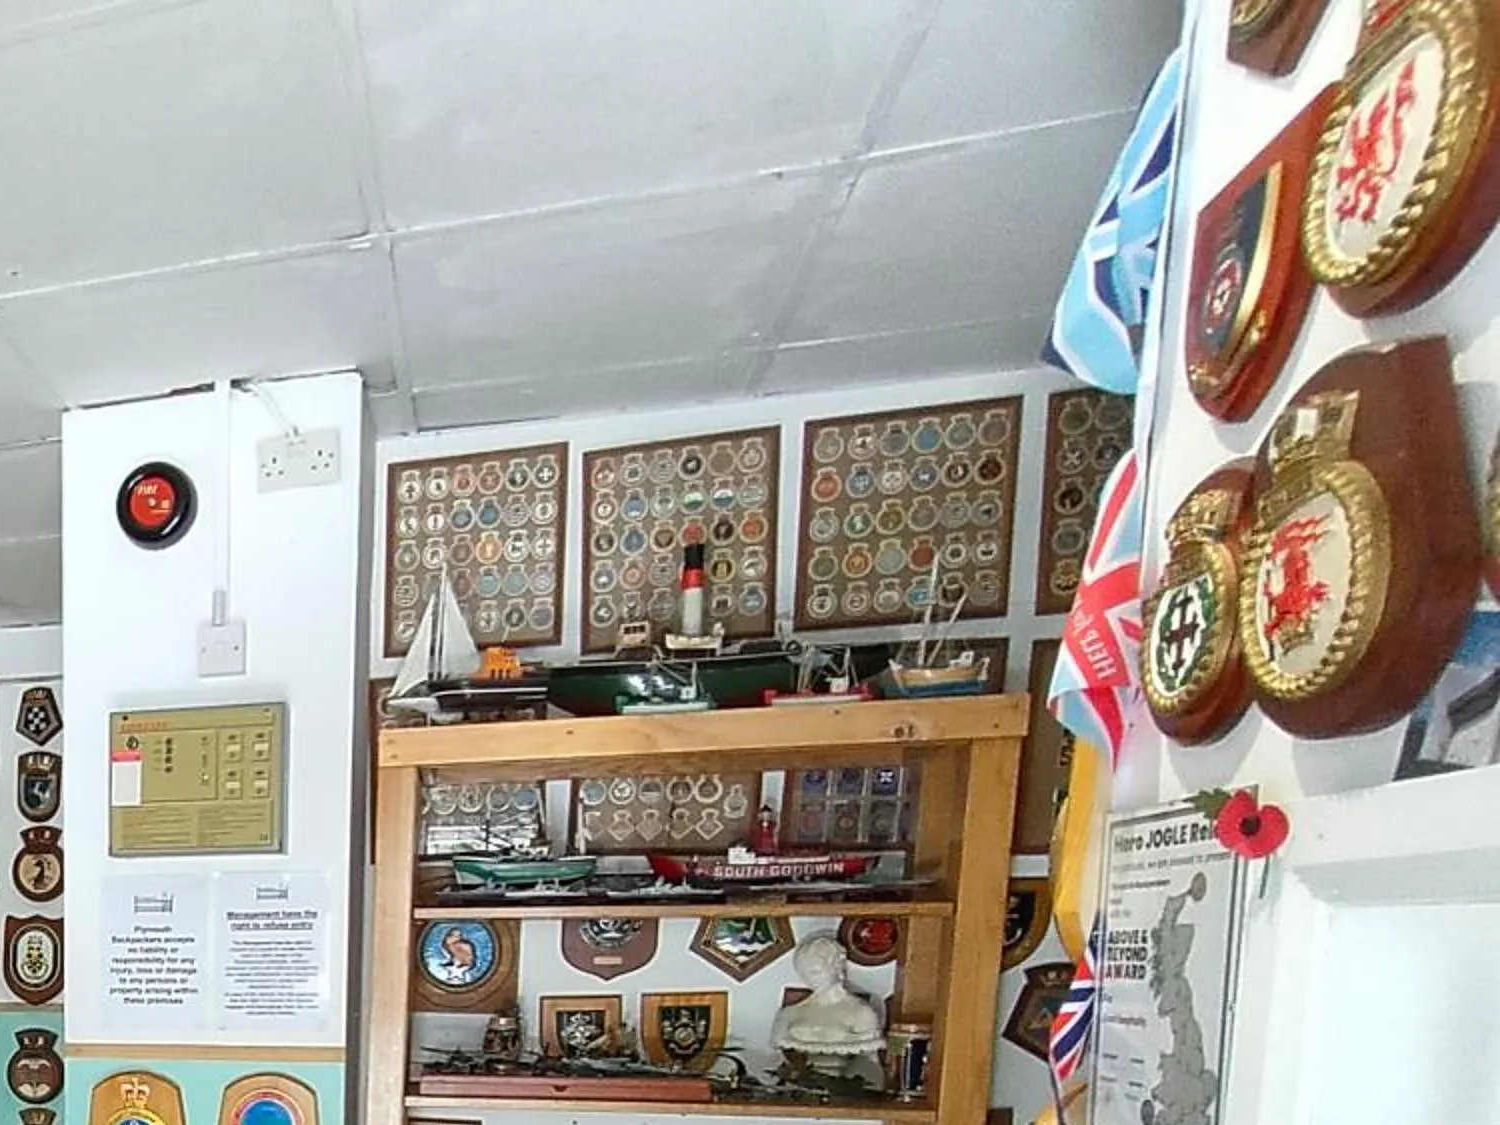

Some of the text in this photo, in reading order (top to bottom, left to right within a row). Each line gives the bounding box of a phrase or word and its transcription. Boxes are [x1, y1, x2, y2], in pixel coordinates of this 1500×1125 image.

[1145, 824, 1187, 849] JOGLE
[1190, 820, 1218, 843] Rel
[713, 862, 845, 878] SOUTH GOODWIN
[226, 911, 280, 920] Management
[133, 925, 173, 935] Plymouth
[1107, 929, 1139, 945] ABOVE
[111, 936, 162, 945] Backpackers
[1106, 946, 1148, 961] BEYOND
[111, 957, 165, 966] responsibility
[1105, 964, 1146, 980] AWARD
